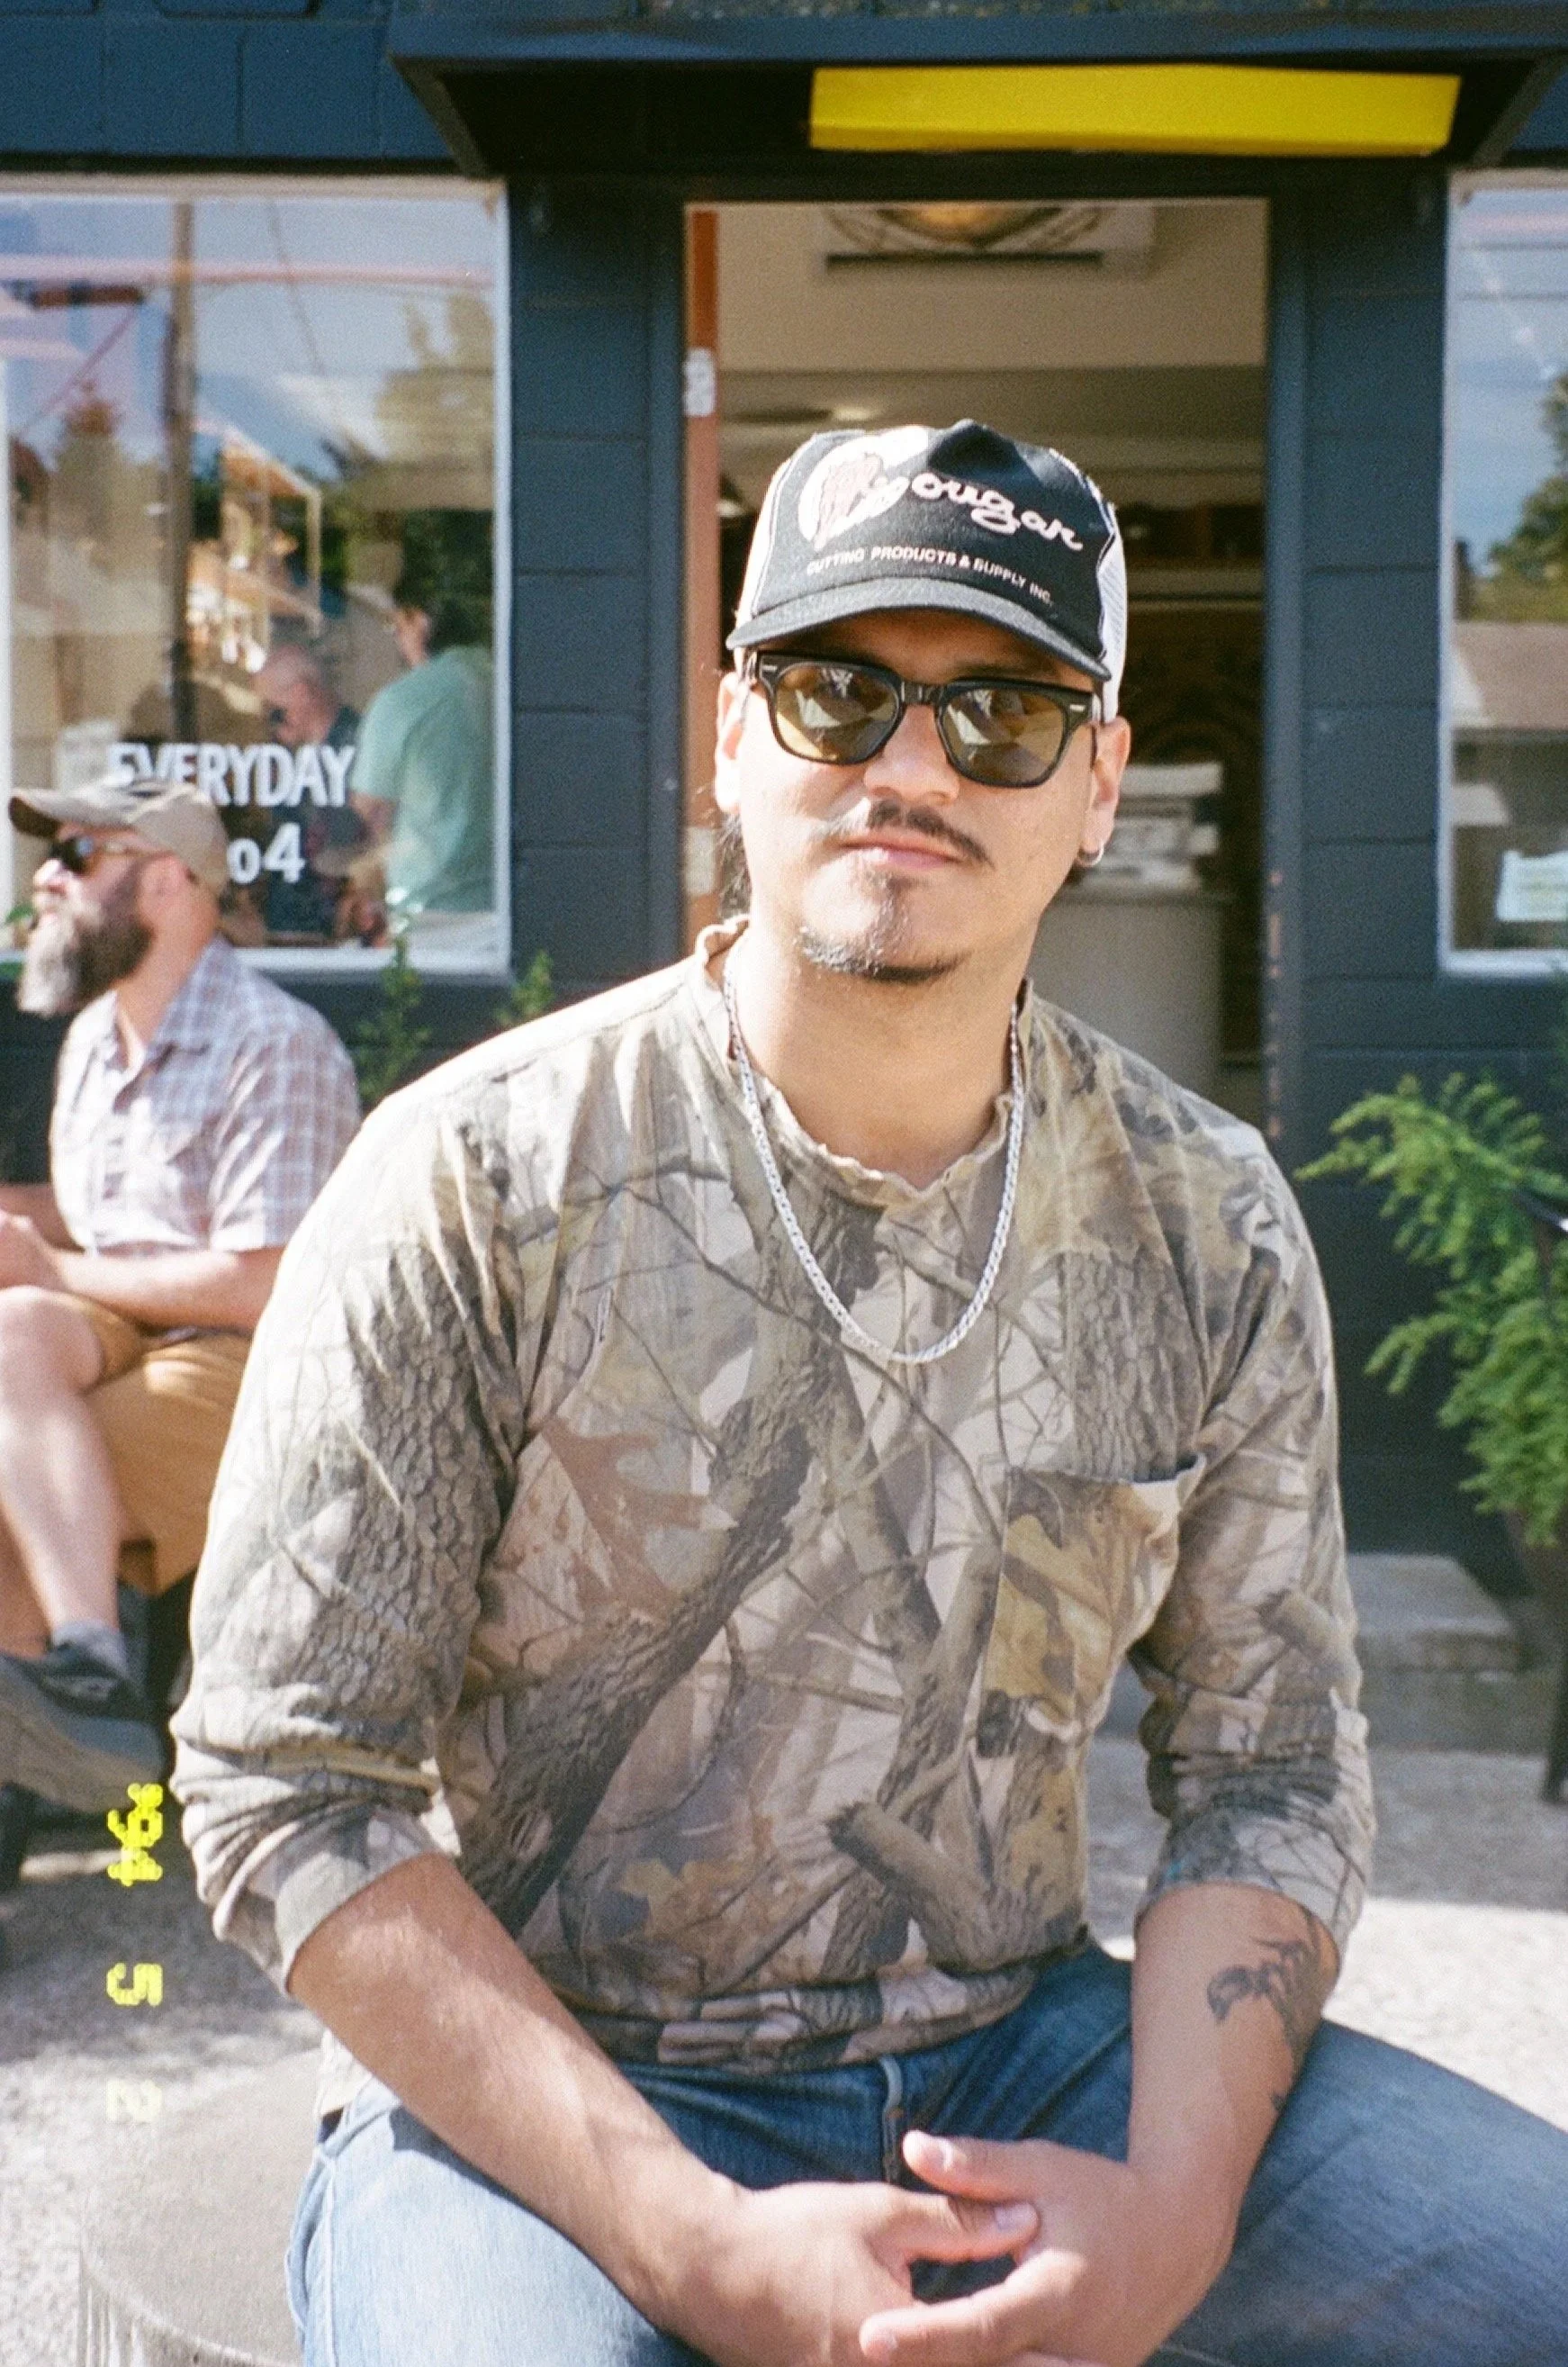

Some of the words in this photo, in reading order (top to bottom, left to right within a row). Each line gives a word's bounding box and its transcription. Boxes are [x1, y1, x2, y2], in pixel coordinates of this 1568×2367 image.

[807, 547, 865, 576] CUTTING
[870, 546, 957, 566] PRODUCTS
[958, 554, 970, 569] &
[973, 557, 1027, 588] SUPPLY
